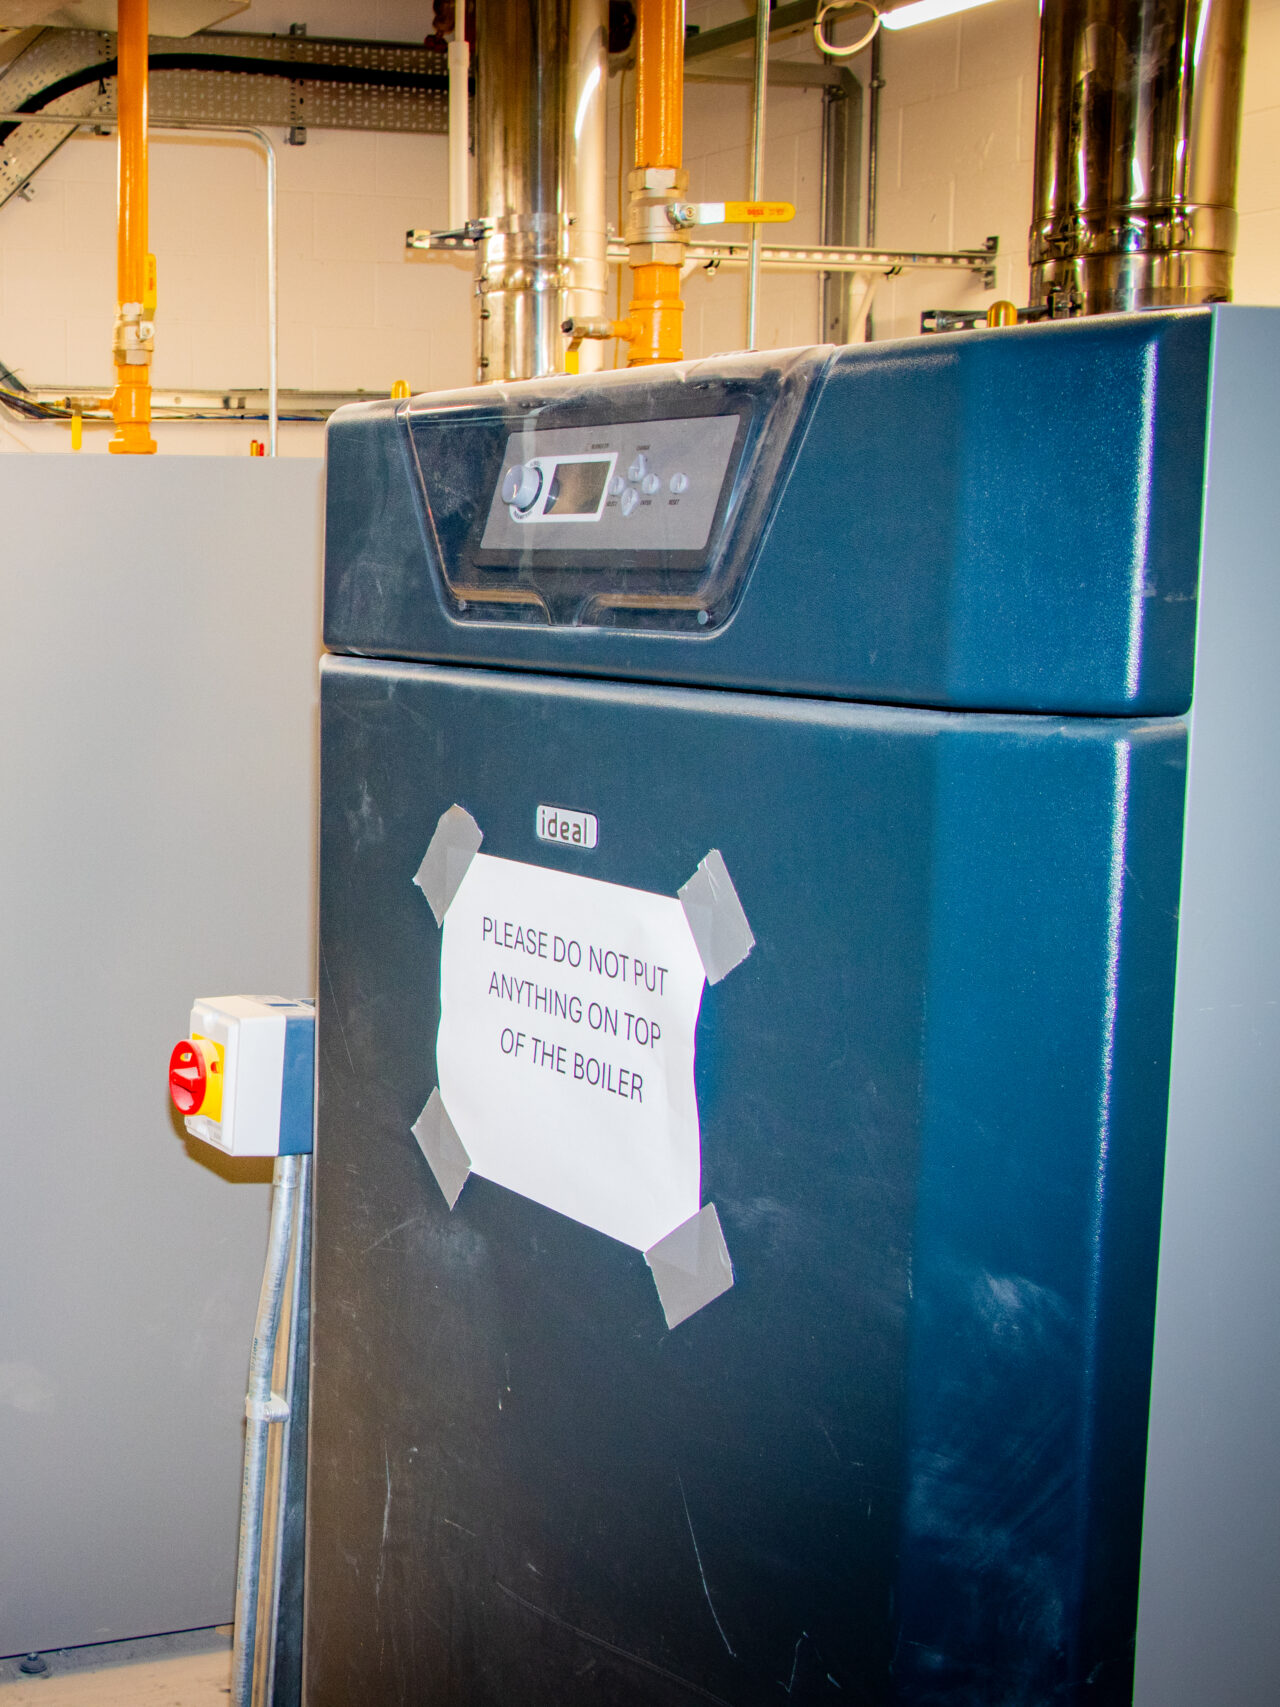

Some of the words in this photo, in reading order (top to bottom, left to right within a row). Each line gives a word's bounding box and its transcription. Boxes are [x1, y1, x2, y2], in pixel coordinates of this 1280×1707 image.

[542, 809, 588, 845] ideal
[483, 916, 548, 959] PLEASE
[553, 935, 582, 968] DO
[589, 945, 629, 982] NOT
[634, 958, 669, 996] PUT
[488, 971, 583, 1024] ANYTHING
[588, 1002, 618, 1036] ON
[624, 1012, 661, 1049] TOP
[500, 1027, 526, 1057] OF
[531, 1036, 567, 1074] THE
[573, 1052, 643, 1103] BOILER
